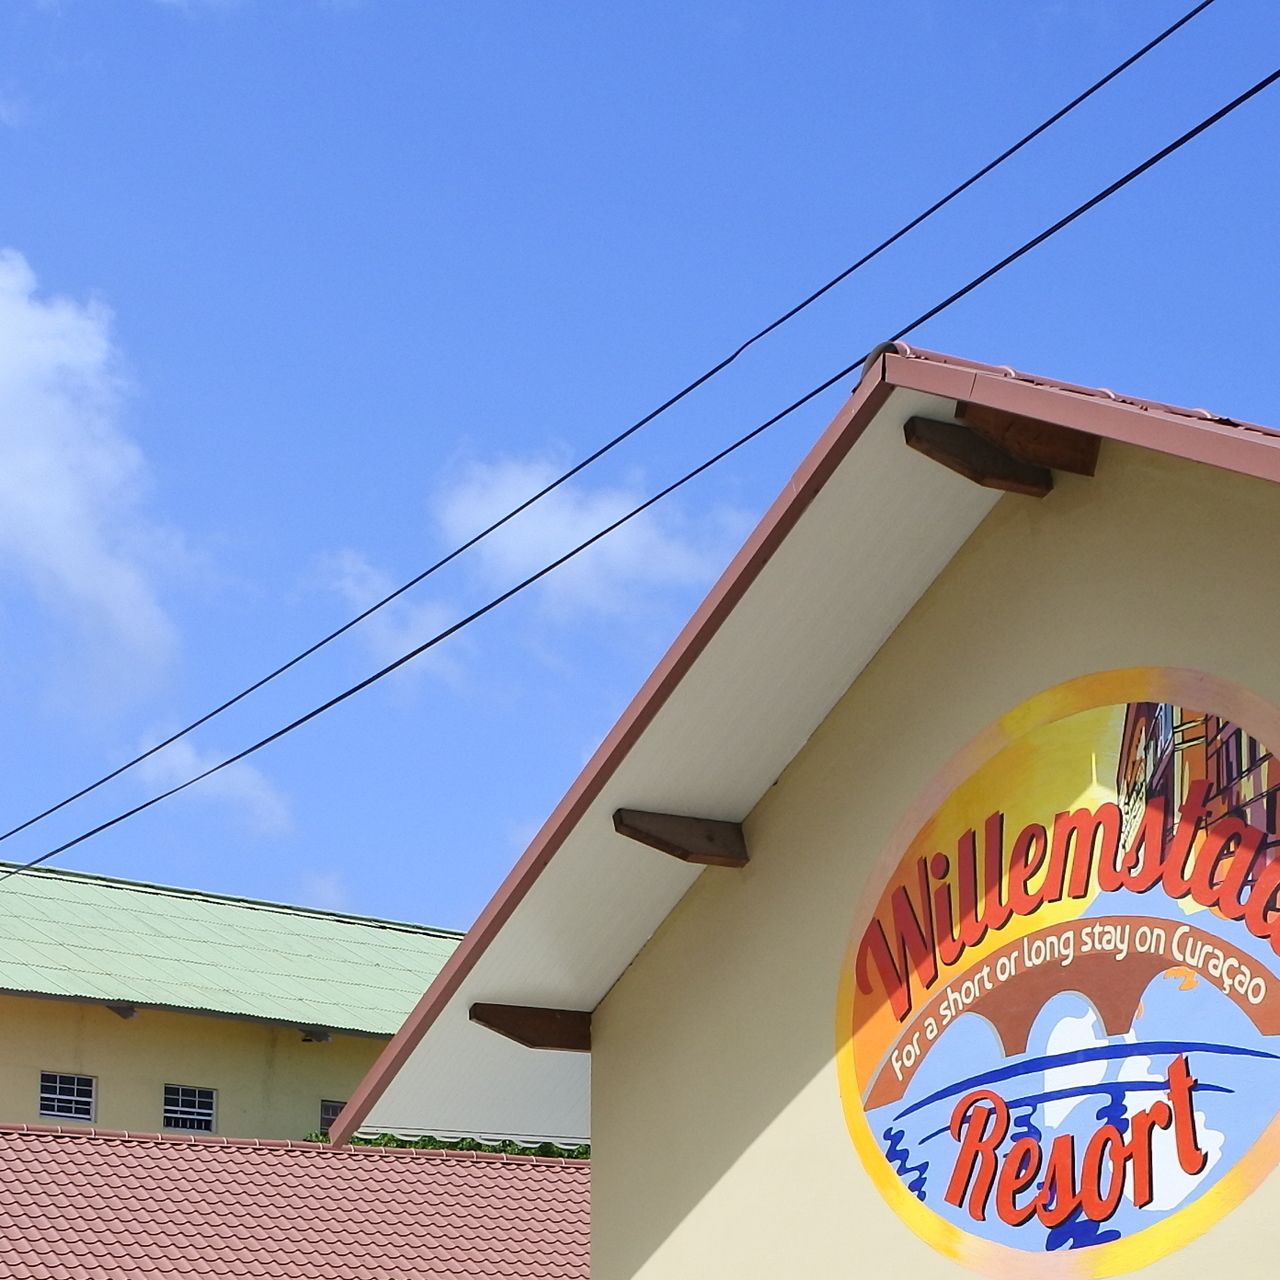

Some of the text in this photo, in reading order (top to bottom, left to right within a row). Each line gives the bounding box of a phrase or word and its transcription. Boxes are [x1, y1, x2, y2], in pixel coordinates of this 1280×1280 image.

[891, 922, 1268, 1081] For a short or long stay on Curaçao
[944, 1053, 1208, 1229] Resort
